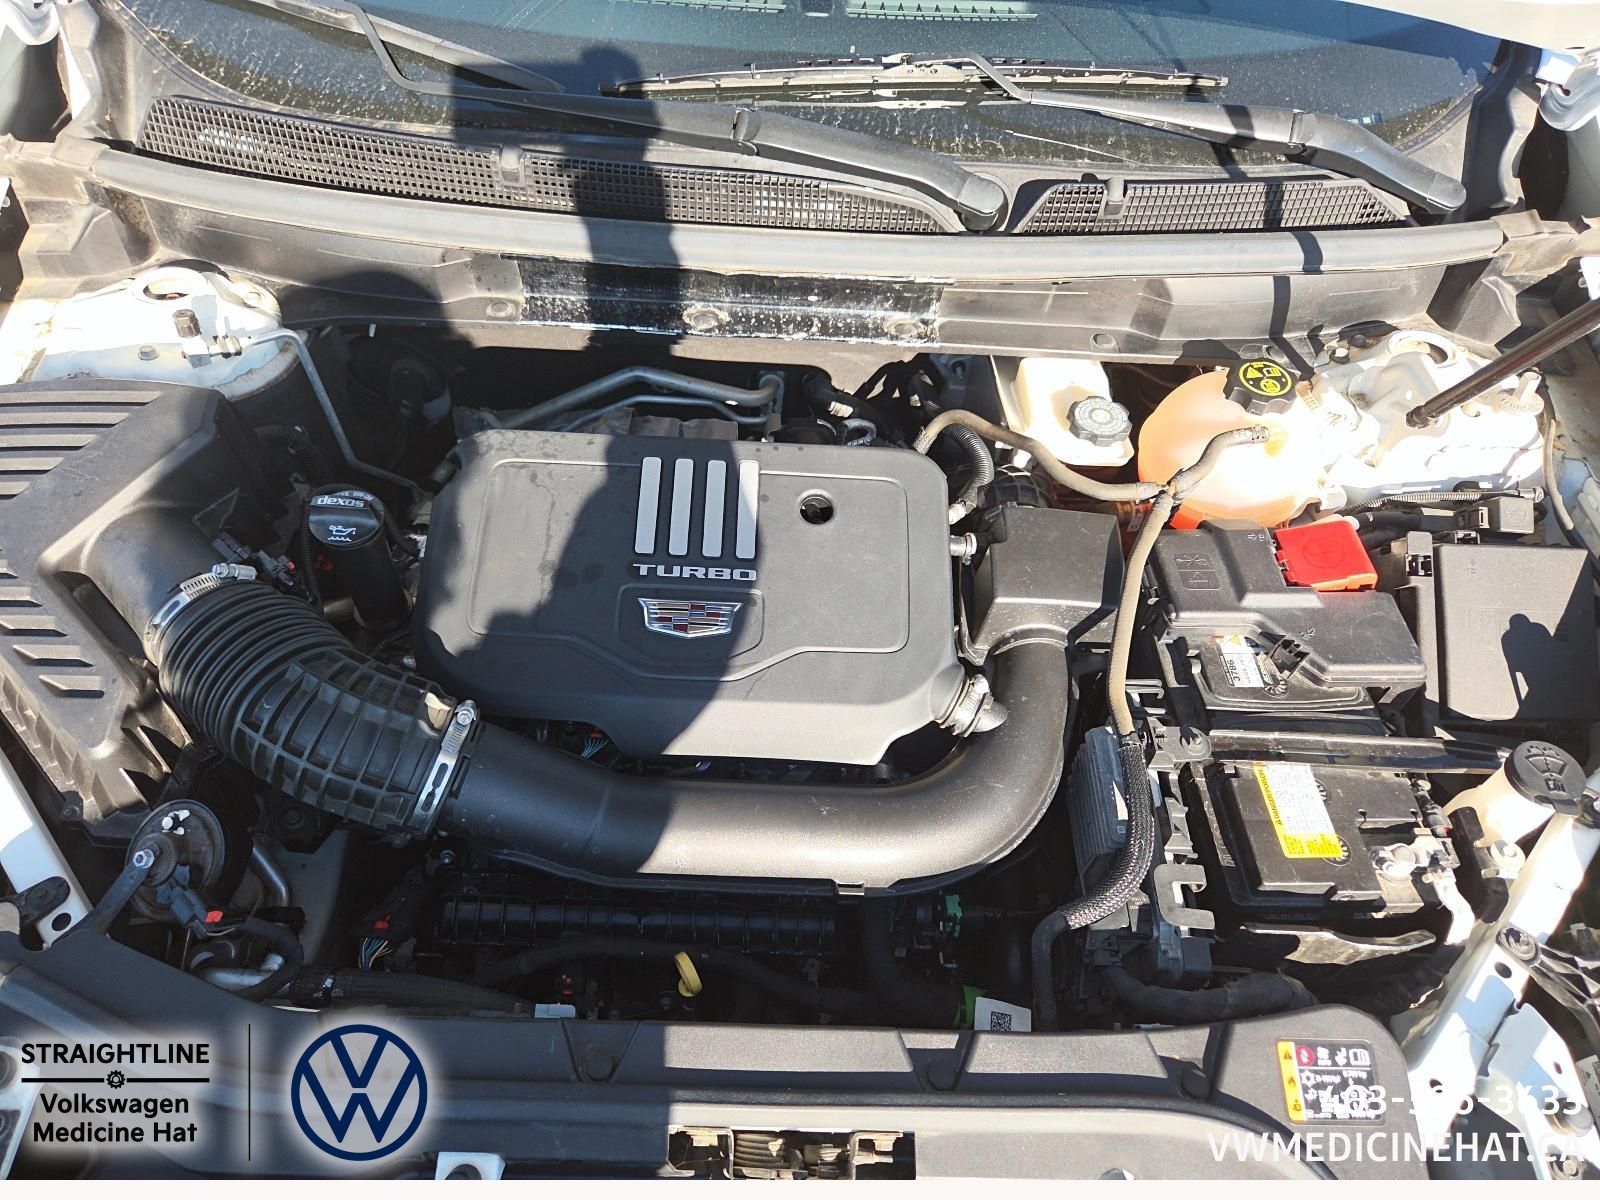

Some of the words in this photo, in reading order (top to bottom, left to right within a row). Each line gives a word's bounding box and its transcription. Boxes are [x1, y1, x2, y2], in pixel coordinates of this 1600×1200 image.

[316, 495, 365, 508] dexos
[632, 563, 757, 581] TURBO
[1226, 659, 1241, 682] 3786
